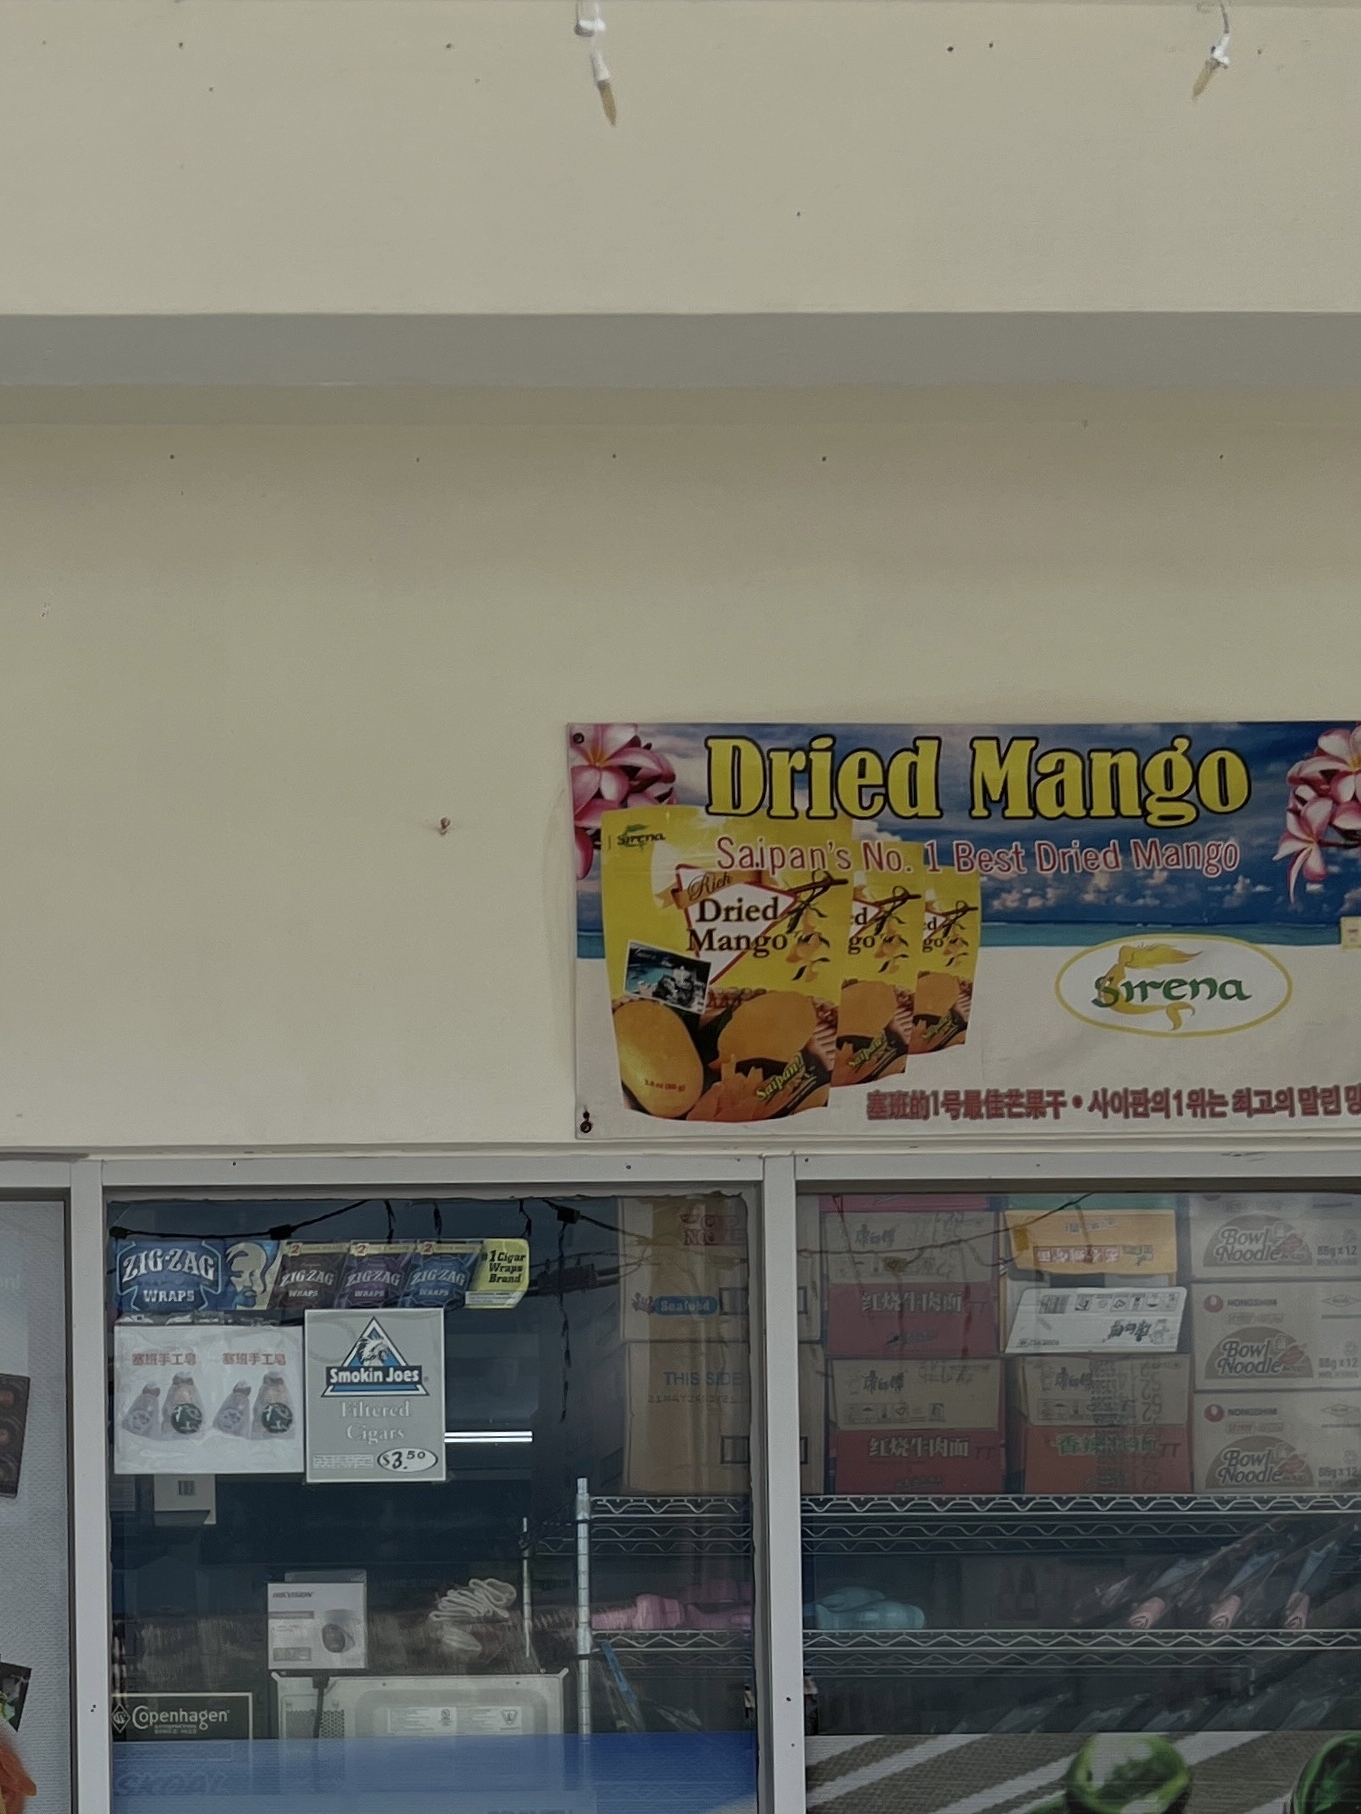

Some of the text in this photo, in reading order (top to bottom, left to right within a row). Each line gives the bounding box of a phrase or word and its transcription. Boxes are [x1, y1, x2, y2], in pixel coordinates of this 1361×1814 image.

[705, 734, 1252, 828] Dried Mango
[617, 831, 666, 848] Sirena
[716, 836, 1241, 876] Saipan's No. 1 Best Dried Mango
[689, 871, 734, 900] Rich
[697, 898, 780, 922] Dried
[687, 928, 789, 957] Mango
[1091, 975, 1252, 1008] Sirena
[866, 1088, 1068, 1121] 塞班的1号最佳芒果干
[1221, 1225, 1269, 1246] Bowl
[497, 1251, 526, 1264] Cigar
[1215, 1244, 1280, 1262] Noodle
[1346, 1245, 1357, 1255] 12
[489, 1262, 523, 1274] Wraps
[488, 1273, 522, 1283] Brand
[143, 1289, 196, 1302] WRAPS
[862, 1290, 964, 1313] 红烧牛肉面
[1222, 1339, 1270, 1358] Bowl
[1217, 1356, 1281, 1374] Noodle
[1347, 1357, 1358, 1367] 12
[329, 1367, 420, 1383] Smokin Joes
[663, 1371, 744, 1386] THIS SIDE
[341, 1400, 411, 1418] Filtered
[347, 1424, 405, 1444] Cigars
[869, 1436, 970, 1458] 红烧牛肉面
[1223, 1448, 1272, 1467] Bowl
[1218, 1465, 1282, 1484] Noodle
[132, 1705, 229, 1730] Copenhagen
